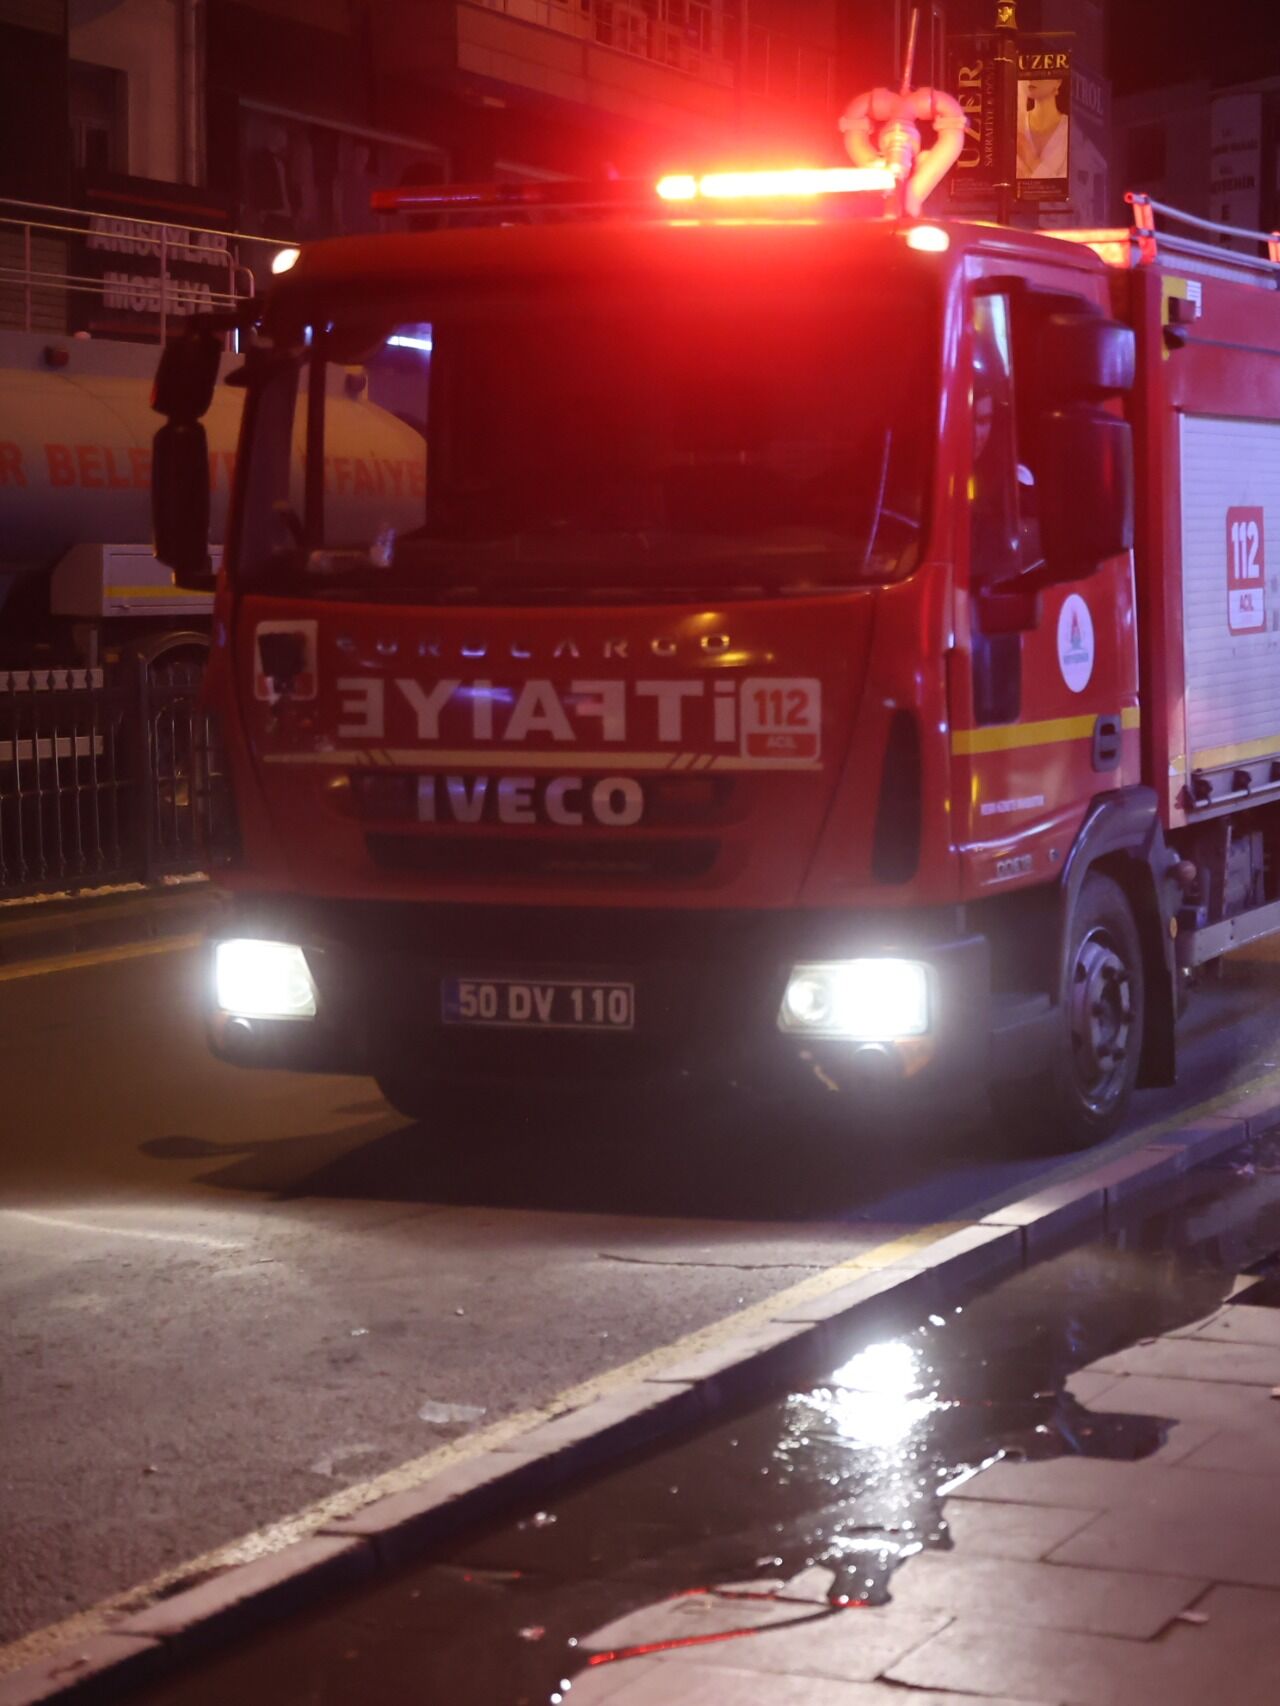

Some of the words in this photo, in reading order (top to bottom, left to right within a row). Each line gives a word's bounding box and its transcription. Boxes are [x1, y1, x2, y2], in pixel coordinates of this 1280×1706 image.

[1231, 521, 1259, 579] 112
[752, 688, 809, 726] 112
[417, 775, 644, 826] IVECO
[459, 983, 498, 1018] 50
[509, 985, 555, 1021] DV
[570, 988, 629, 1024] 110
